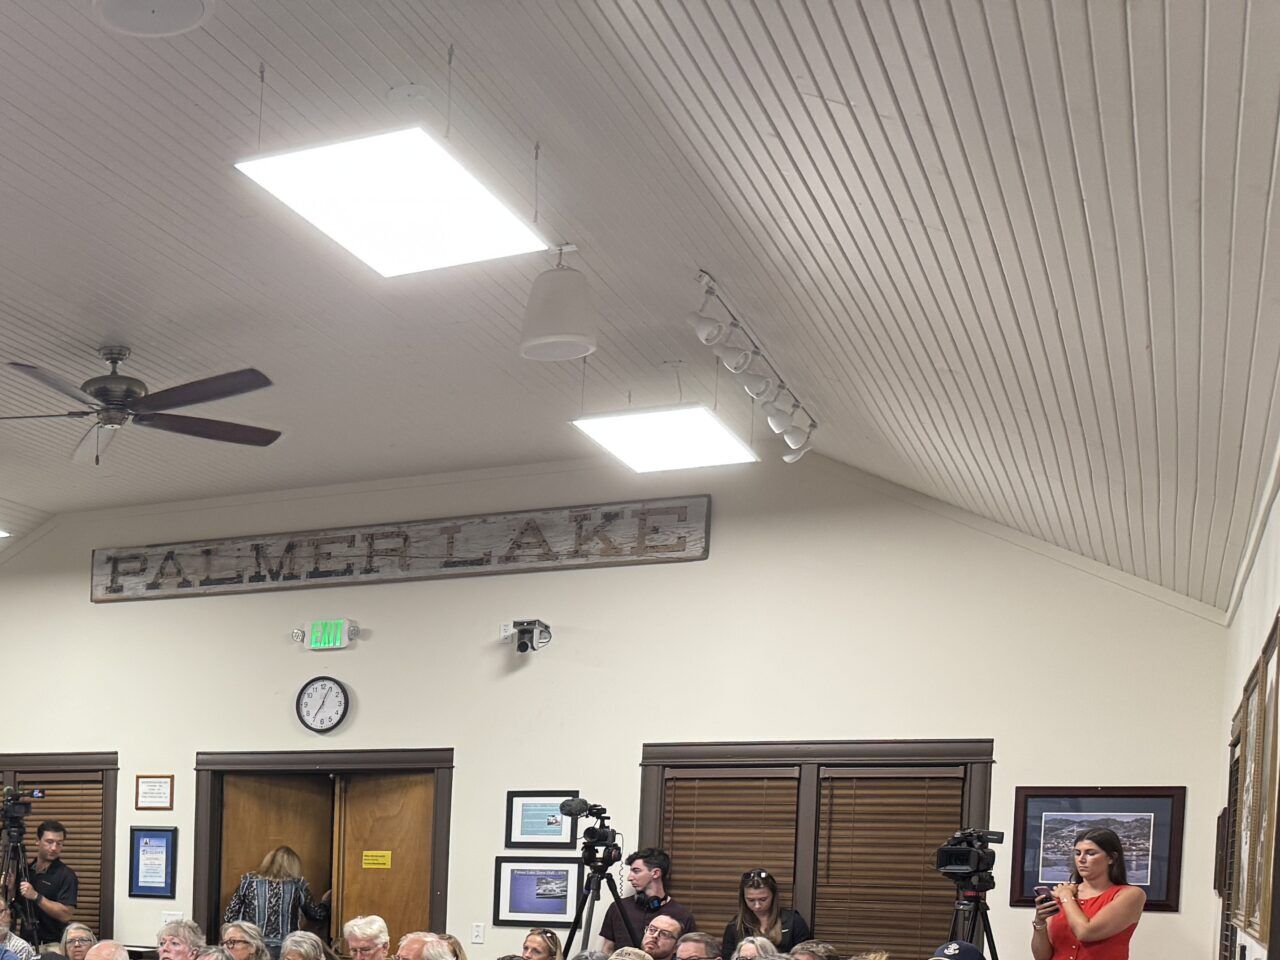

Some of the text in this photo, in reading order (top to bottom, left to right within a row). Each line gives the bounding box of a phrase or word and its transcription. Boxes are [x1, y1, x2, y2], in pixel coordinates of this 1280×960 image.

[105, 505, 688, 593] PALMER LAKE
[310, 619, 344, 648] EXIT
